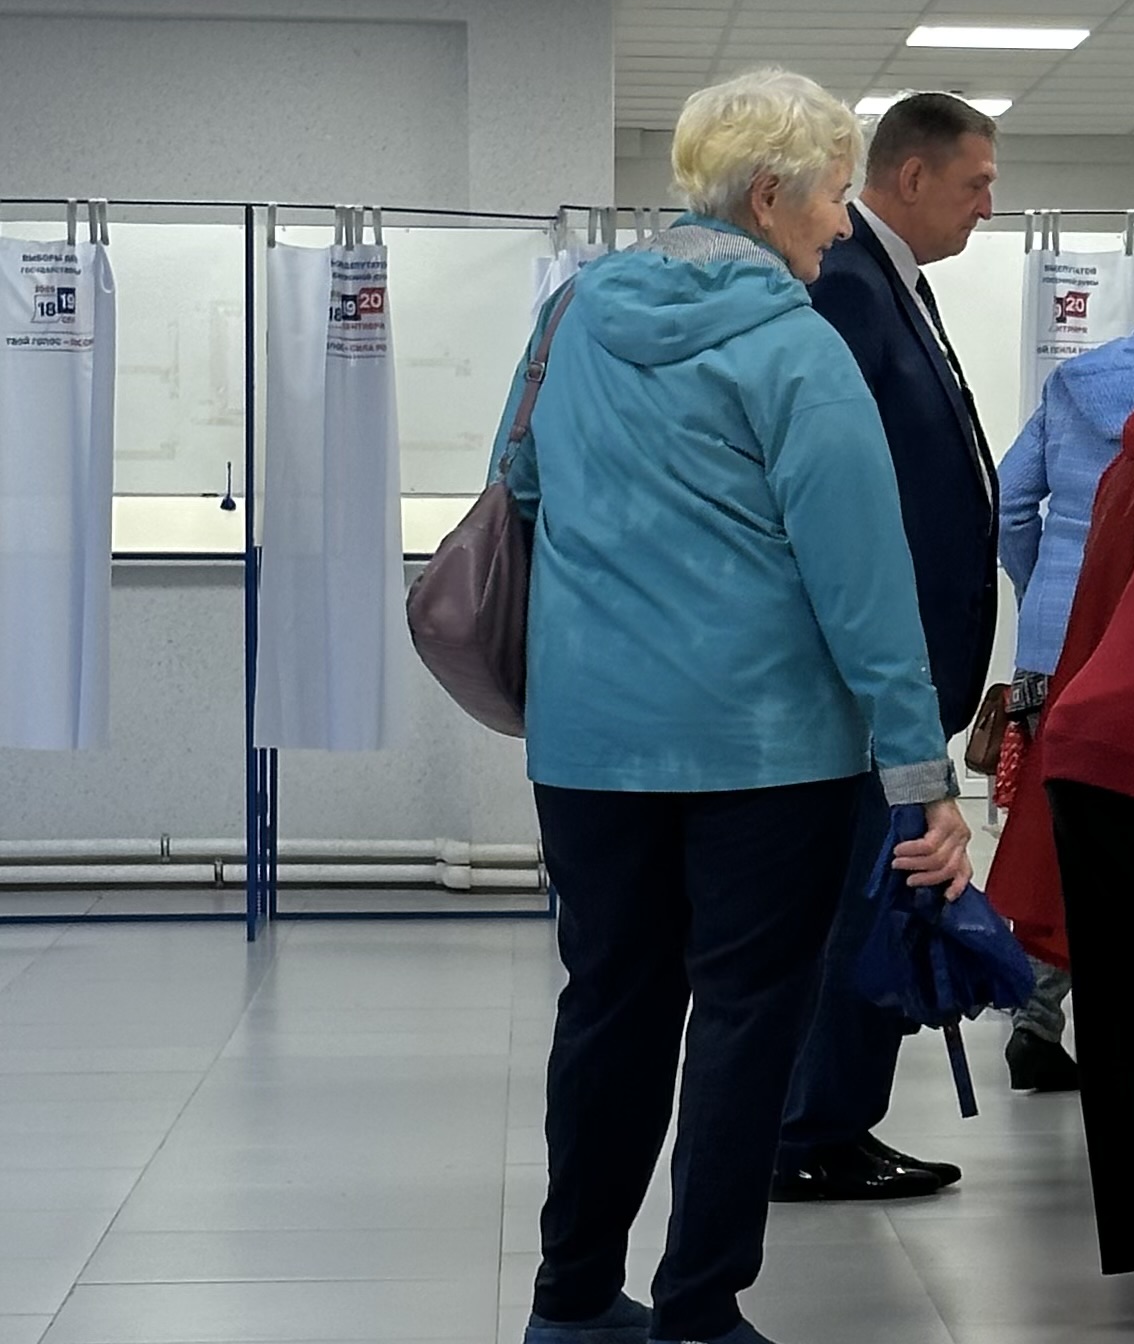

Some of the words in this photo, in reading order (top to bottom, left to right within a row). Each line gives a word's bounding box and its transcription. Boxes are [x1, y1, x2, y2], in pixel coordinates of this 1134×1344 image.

[60, 293, 75, 309] 19
[360, 293, 382, 309] 20
[1065, 297, 1085, 312] 20
[37, 302, 57, 316] 18
